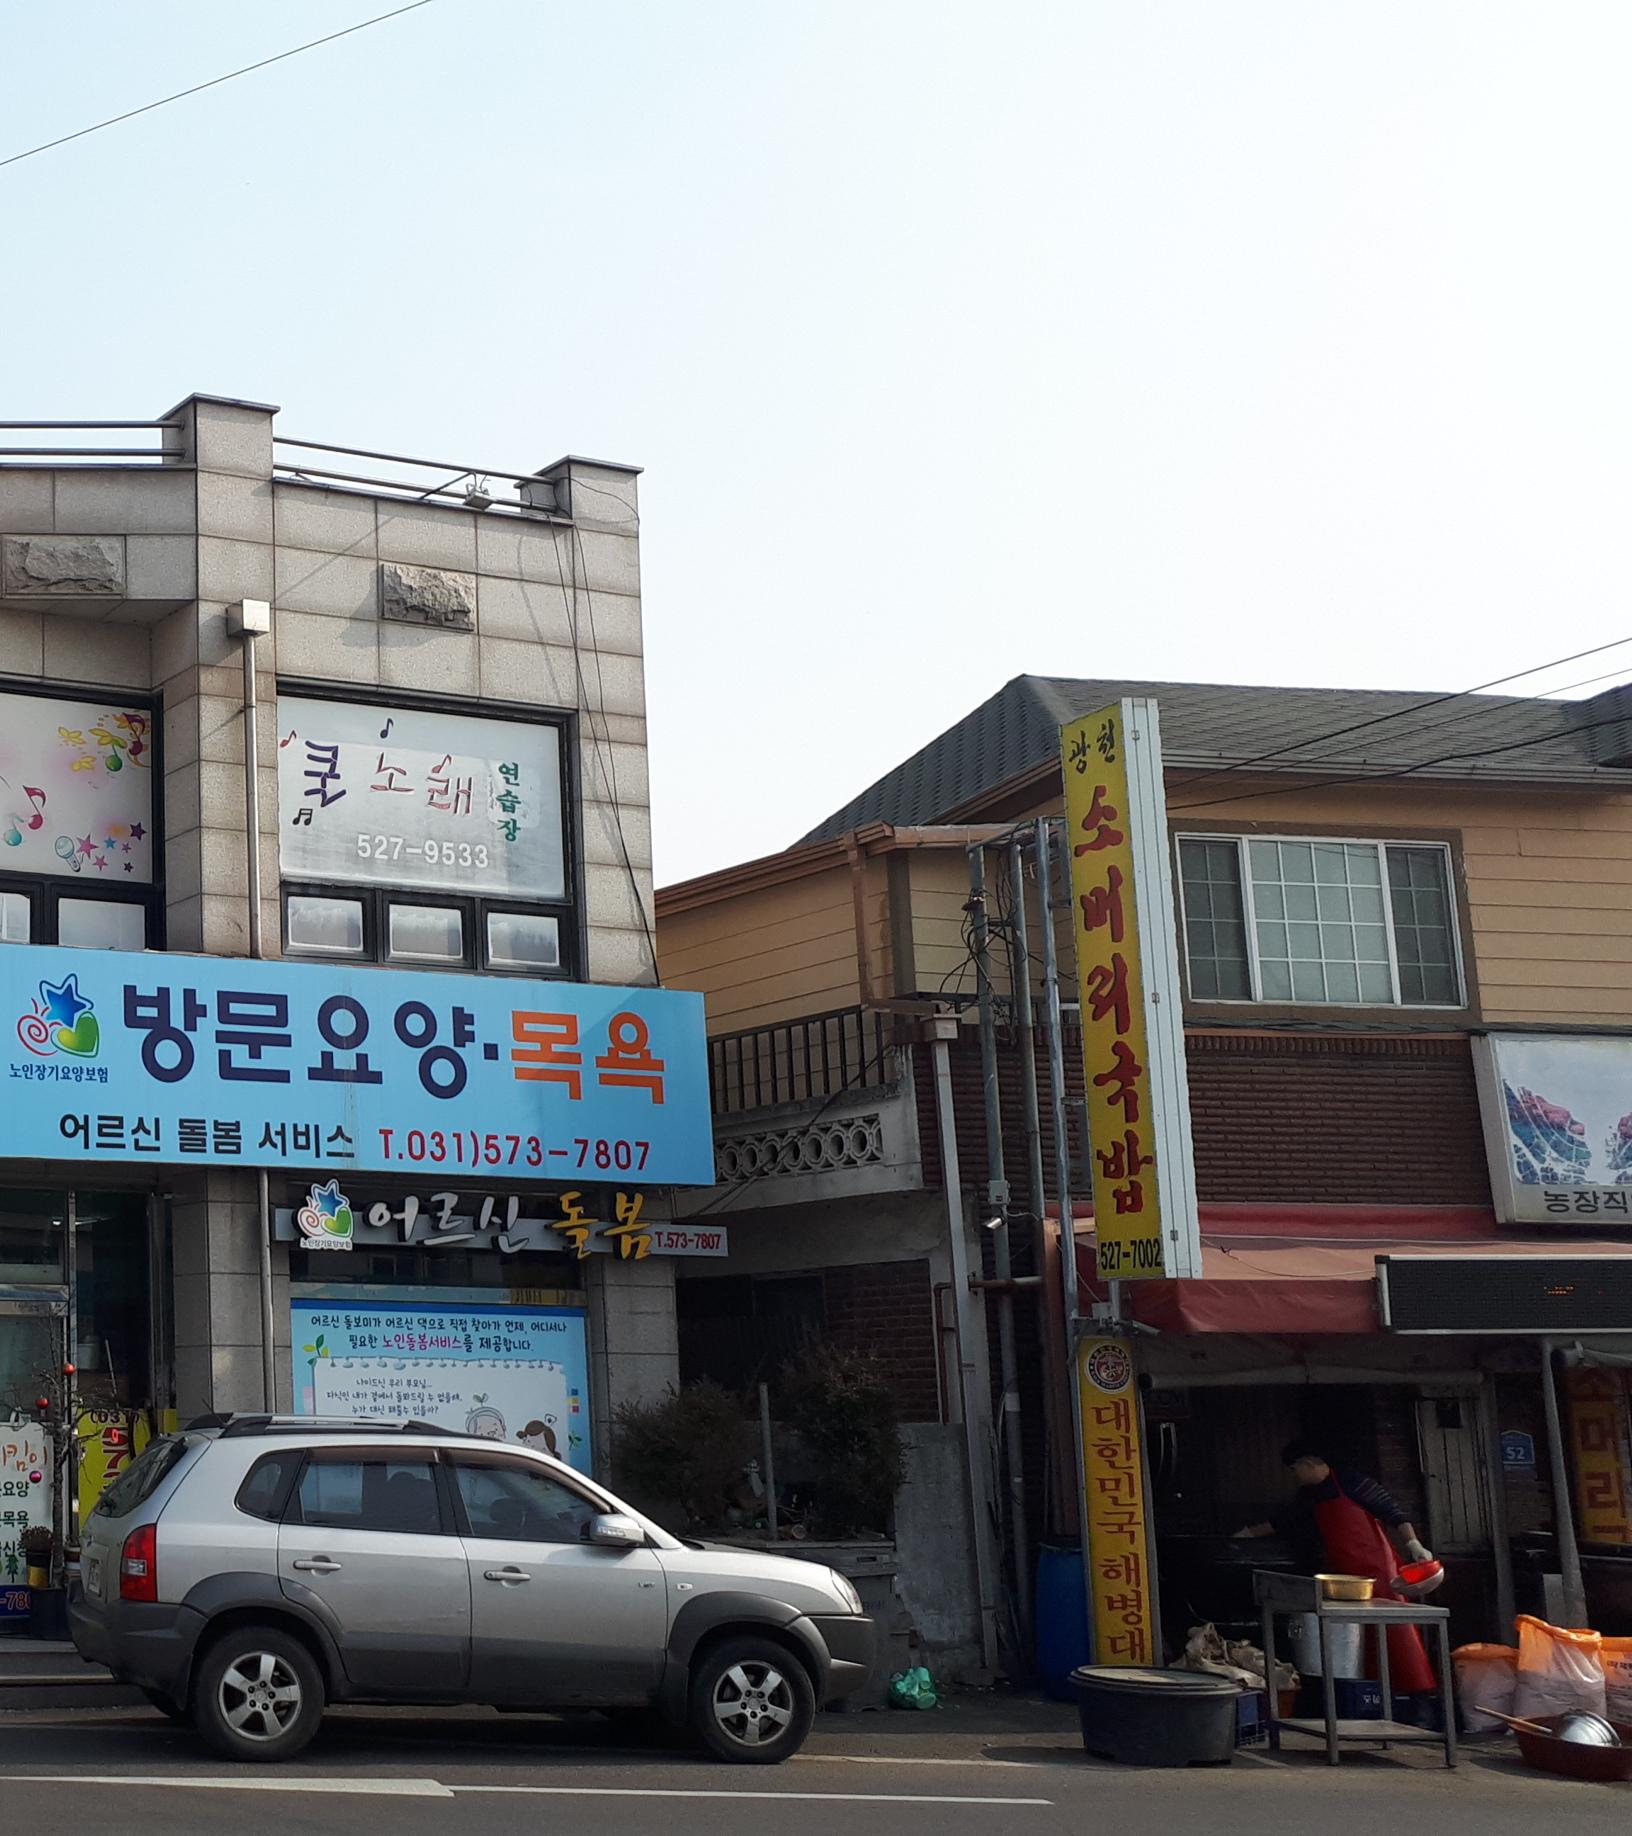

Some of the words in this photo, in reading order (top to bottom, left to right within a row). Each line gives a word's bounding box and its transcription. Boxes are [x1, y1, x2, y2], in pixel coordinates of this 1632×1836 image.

[356, 833, 490, 869] 527-9533
[1074, 785, 1154, 1214] 소머리국밥
[9, 1063, 108, 1083] 노인장기요양보험
[58, 1112, 163, 1150] 어르신
[177, 1117, 243, 1154] 돌봄
[258, 1119, 354, 1160] 서비스
[380, 1127, 652, 1172] T.031)573-7807
[1544, 1191, 1632, 1214] 농장직
[366, 1191, 530, 1254] 어르신
[548, 1189, 653, 1262] 돌봄
[654, 1230, 722, 1251] T.573-7807
[1099, 1238, 1161, 1270] 527-7002
[311, 1315, 340, 1329] 어르신
[344, 1315, 381, 1330] 돌보미가
[385, 1317, 414, 1331] 어르신
[417, 1317, 445, 1331] 댁으로
[449, 1318, 467, 1332] 직접
[471, 1318, 500, 1332] 찾아가
[530, 1321, 567, 1333] 어디서나
[349, 1334, 377, 1349] 필요한
[382, 1333, 474, 1353] 노인돌봄서비스를
[479, 1335, 534, 1352] 제공합니다.
[356, 1378, 386, 1389] 나이드신
[388, 1378, 403, 1388] 우리
[90, 1410, 139, 1424] (031)
[1506, 1446, 1526, 1460] 52
[1092, 1398, 1142, 1545] 대한민국
[1101, 1553, 1146, 1665] 해병대
